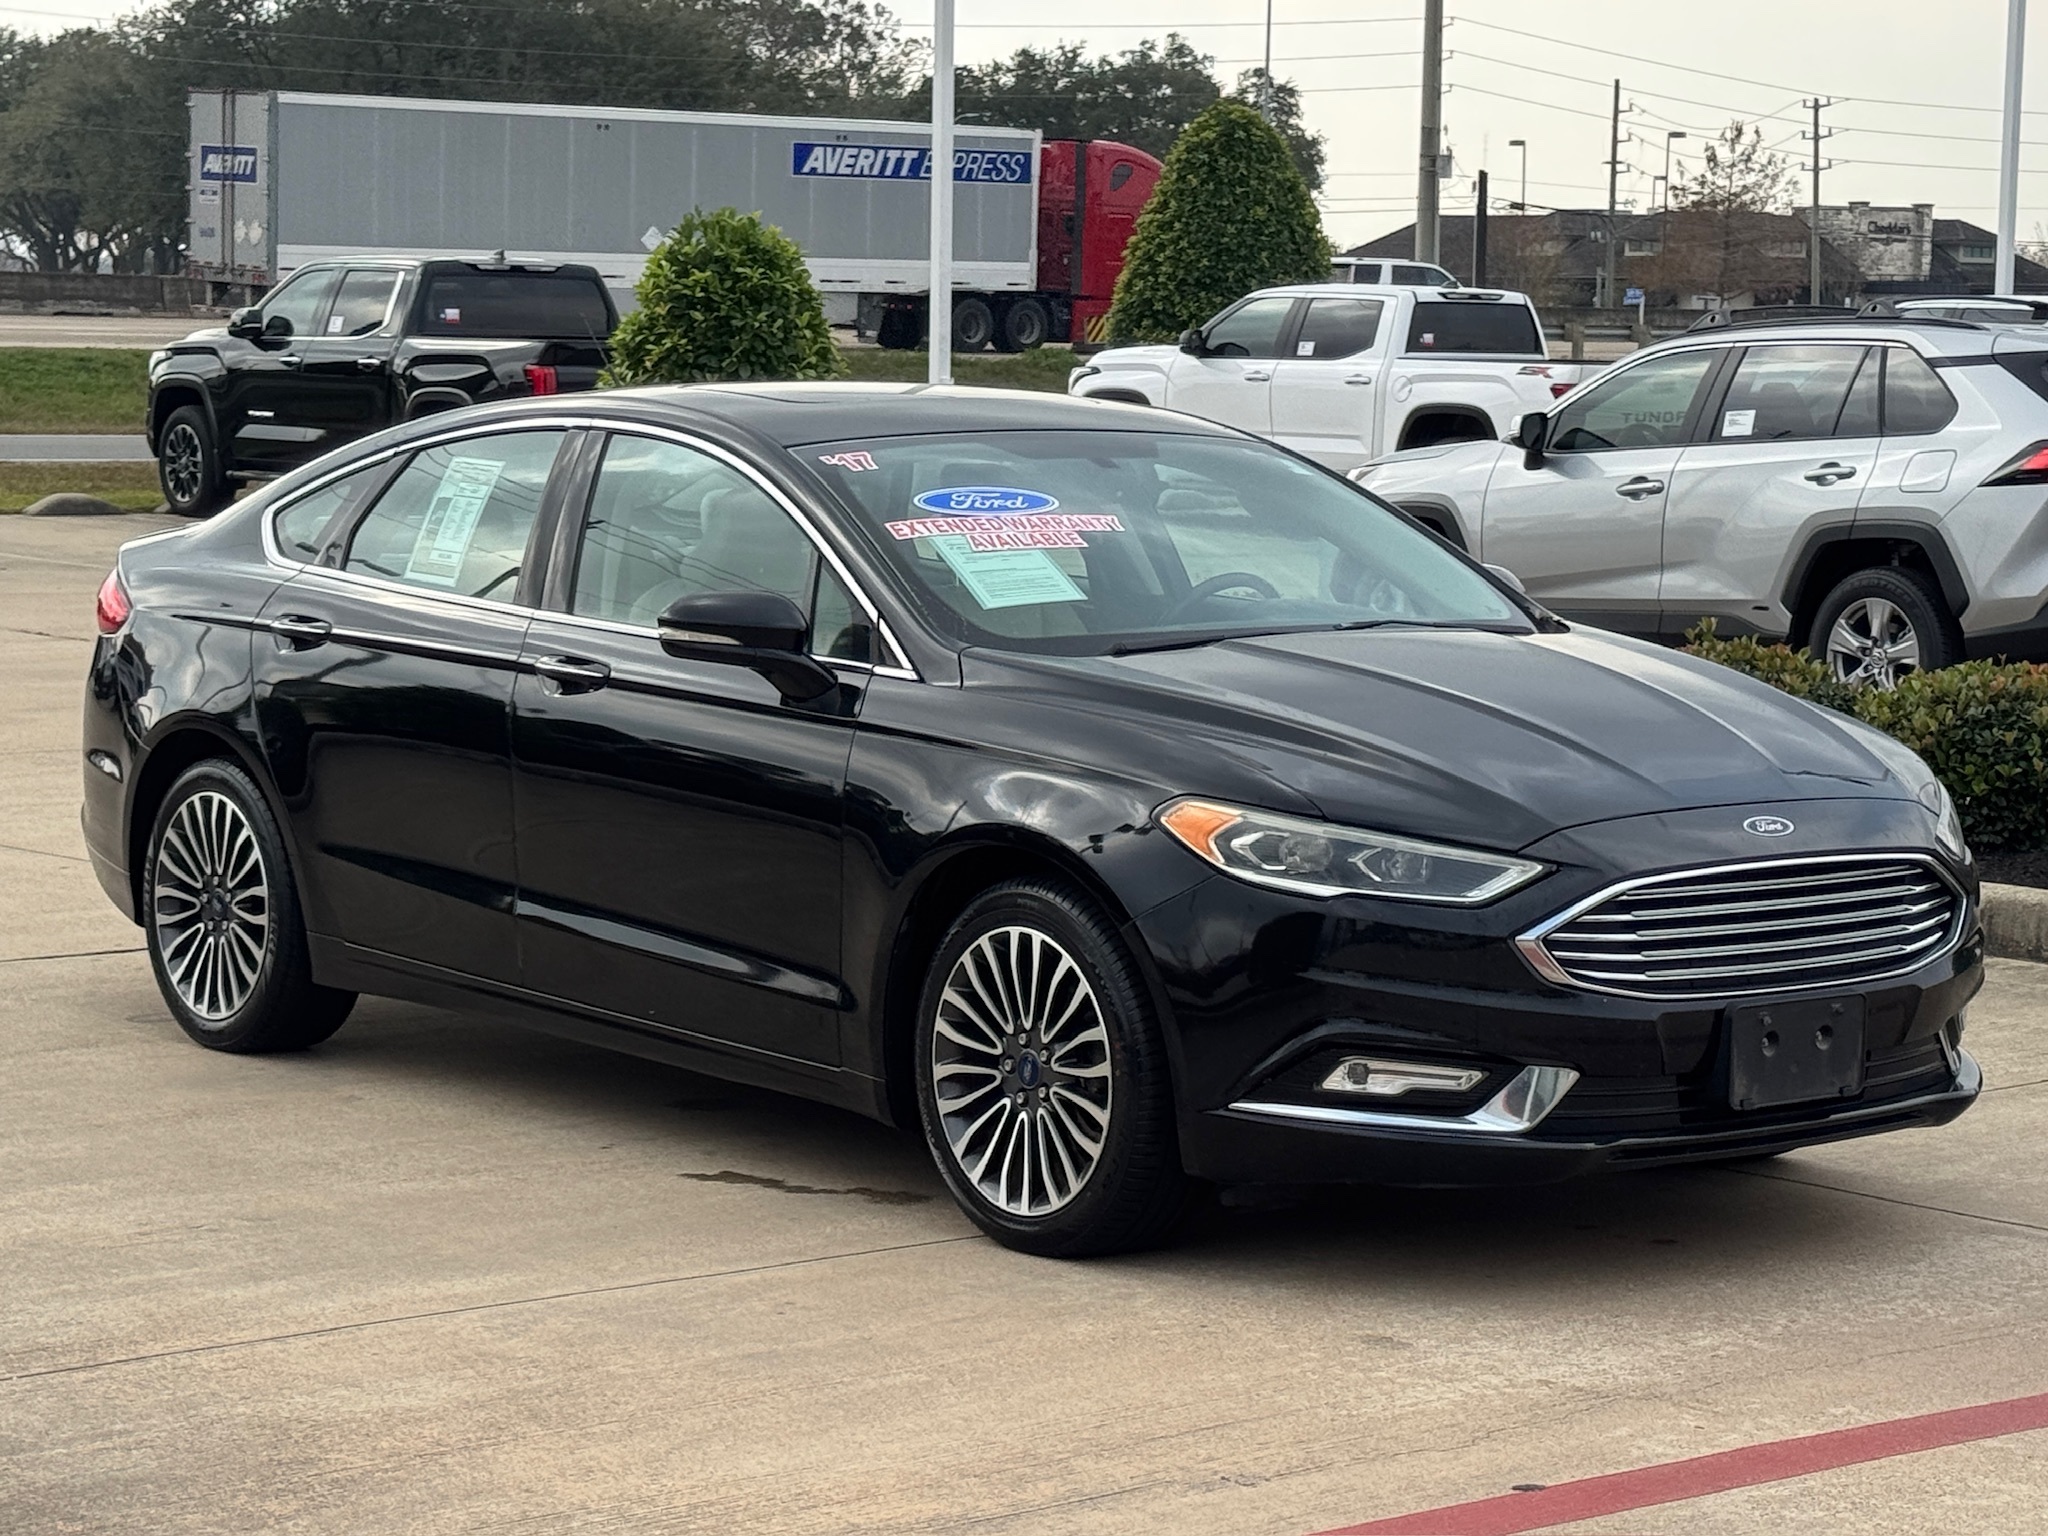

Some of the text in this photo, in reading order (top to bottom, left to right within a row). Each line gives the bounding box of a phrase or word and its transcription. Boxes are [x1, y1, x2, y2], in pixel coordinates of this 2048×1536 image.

[800, 146, 1026, 181] AVERITT EPRESS
[1620, 410, 1688, 424] TUNDR
[949, 492, 1030, 509] Ford
[888, 515, 1121, 538] EXTENDED WARRANTY
[968, 531, 1085, 550] AVAILABLE
[1755, 819, 1784, 832] Ford
